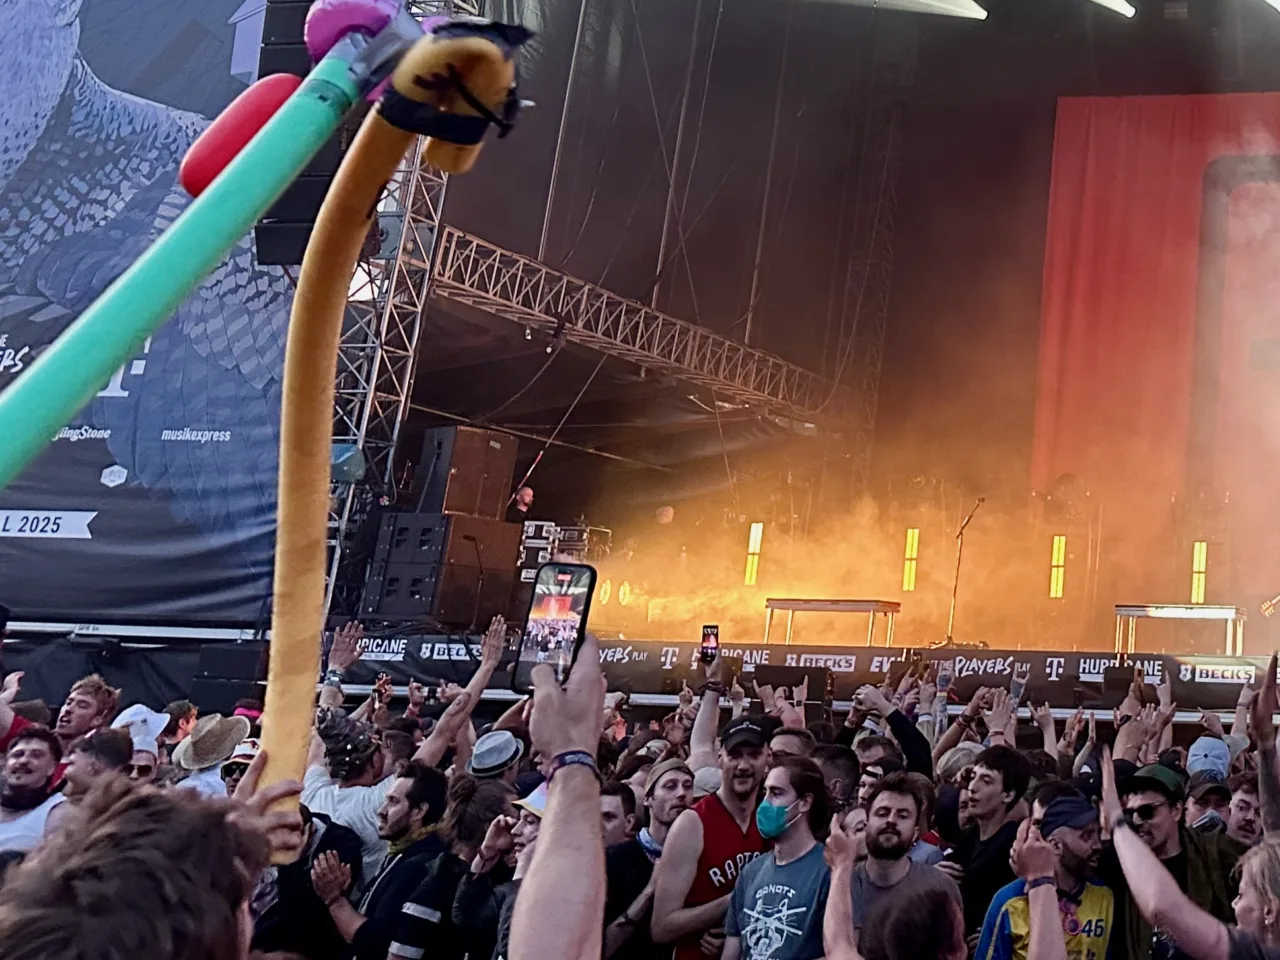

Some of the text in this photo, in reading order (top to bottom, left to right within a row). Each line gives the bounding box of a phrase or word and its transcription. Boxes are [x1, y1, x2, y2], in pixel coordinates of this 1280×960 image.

[161, 427, 231, 443] musikexpress
[18, 515, 62, 533] 2025
[599, 645, 648, 664] YERS PLAY
[802, 656, 853, 669] BECK'S
[954, 656, 1014, 678] PLAYERS
[1199, 667, 1253, 680] BECK'S
[1081, 918, 1104, 938] 46
